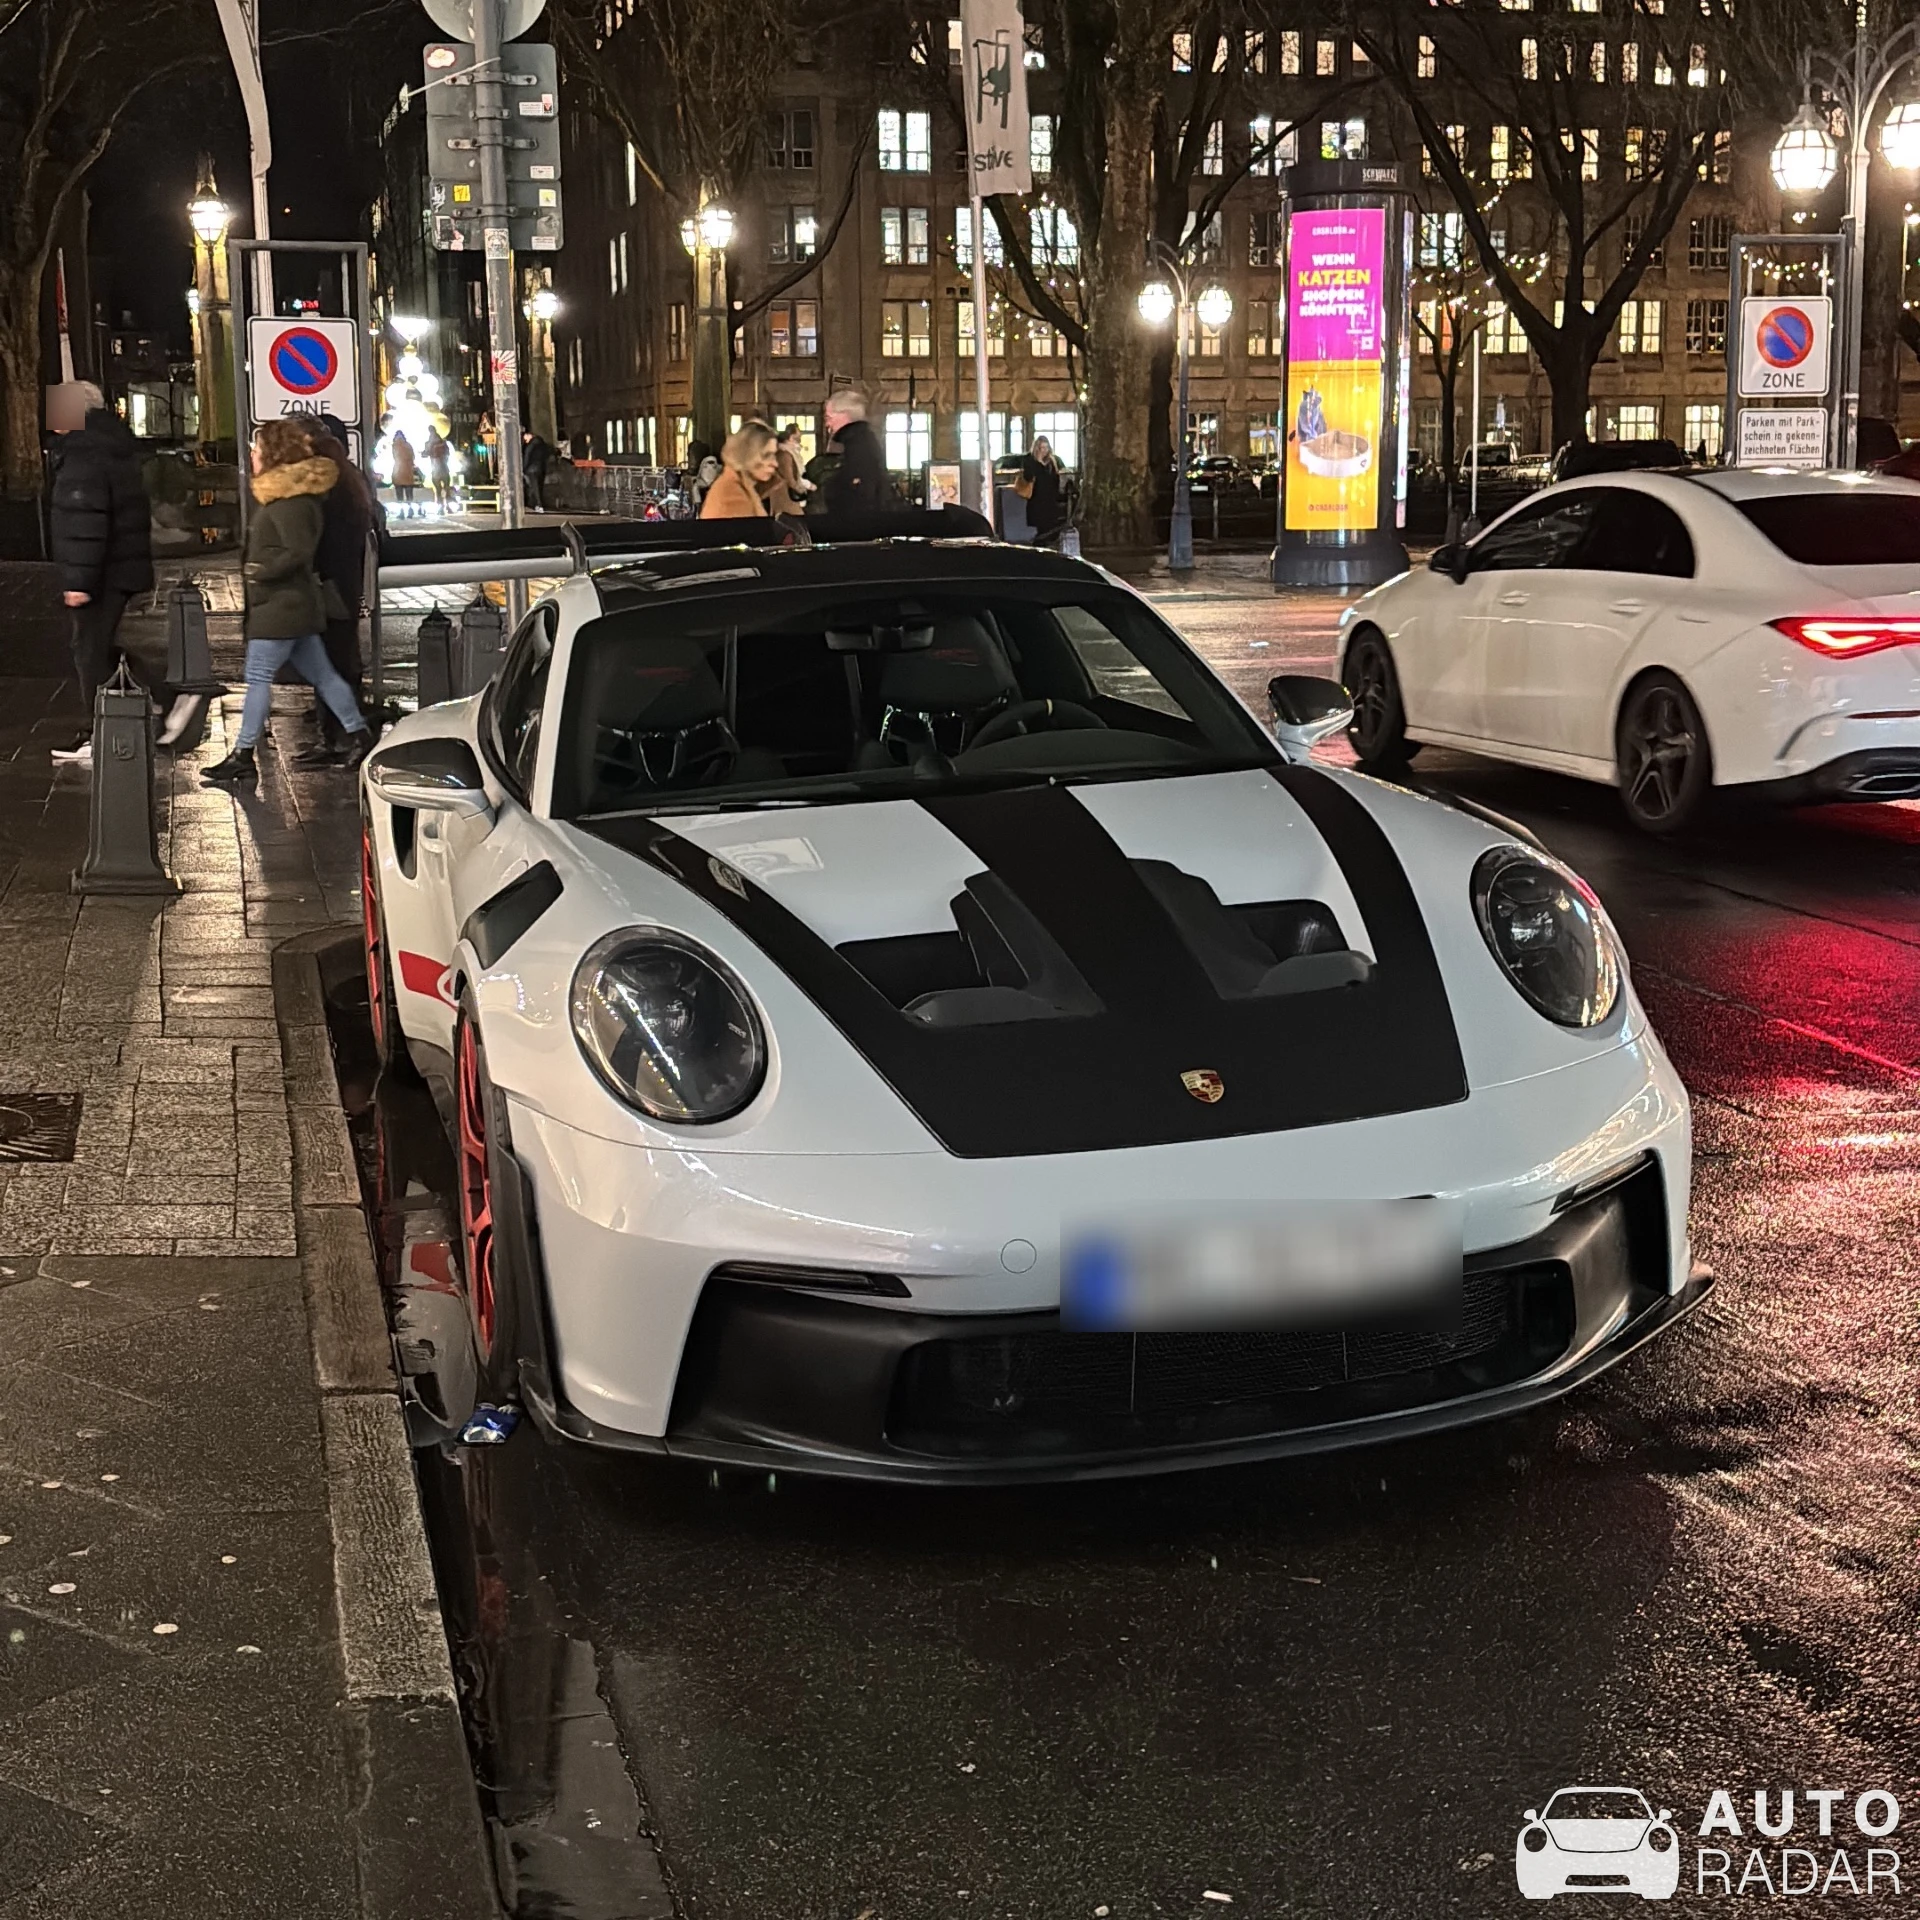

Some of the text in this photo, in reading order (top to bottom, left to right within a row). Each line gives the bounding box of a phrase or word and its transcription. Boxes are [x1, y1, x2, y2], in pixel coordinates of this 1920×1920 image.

[1312, 253, 1355, 266] WENN
[1298, 269, 1370, 286] KATZEN
[1302, 289, 1365, 302] SHOPPEN
[1762, 373, 1806, 388] ZONE
[1746, 416, 1820, 427] Parken mit Park-
[1744, 430, 1820, 443] schein in gekenn-
[1744, 443, 1820, 455] zeichneten Flächen
